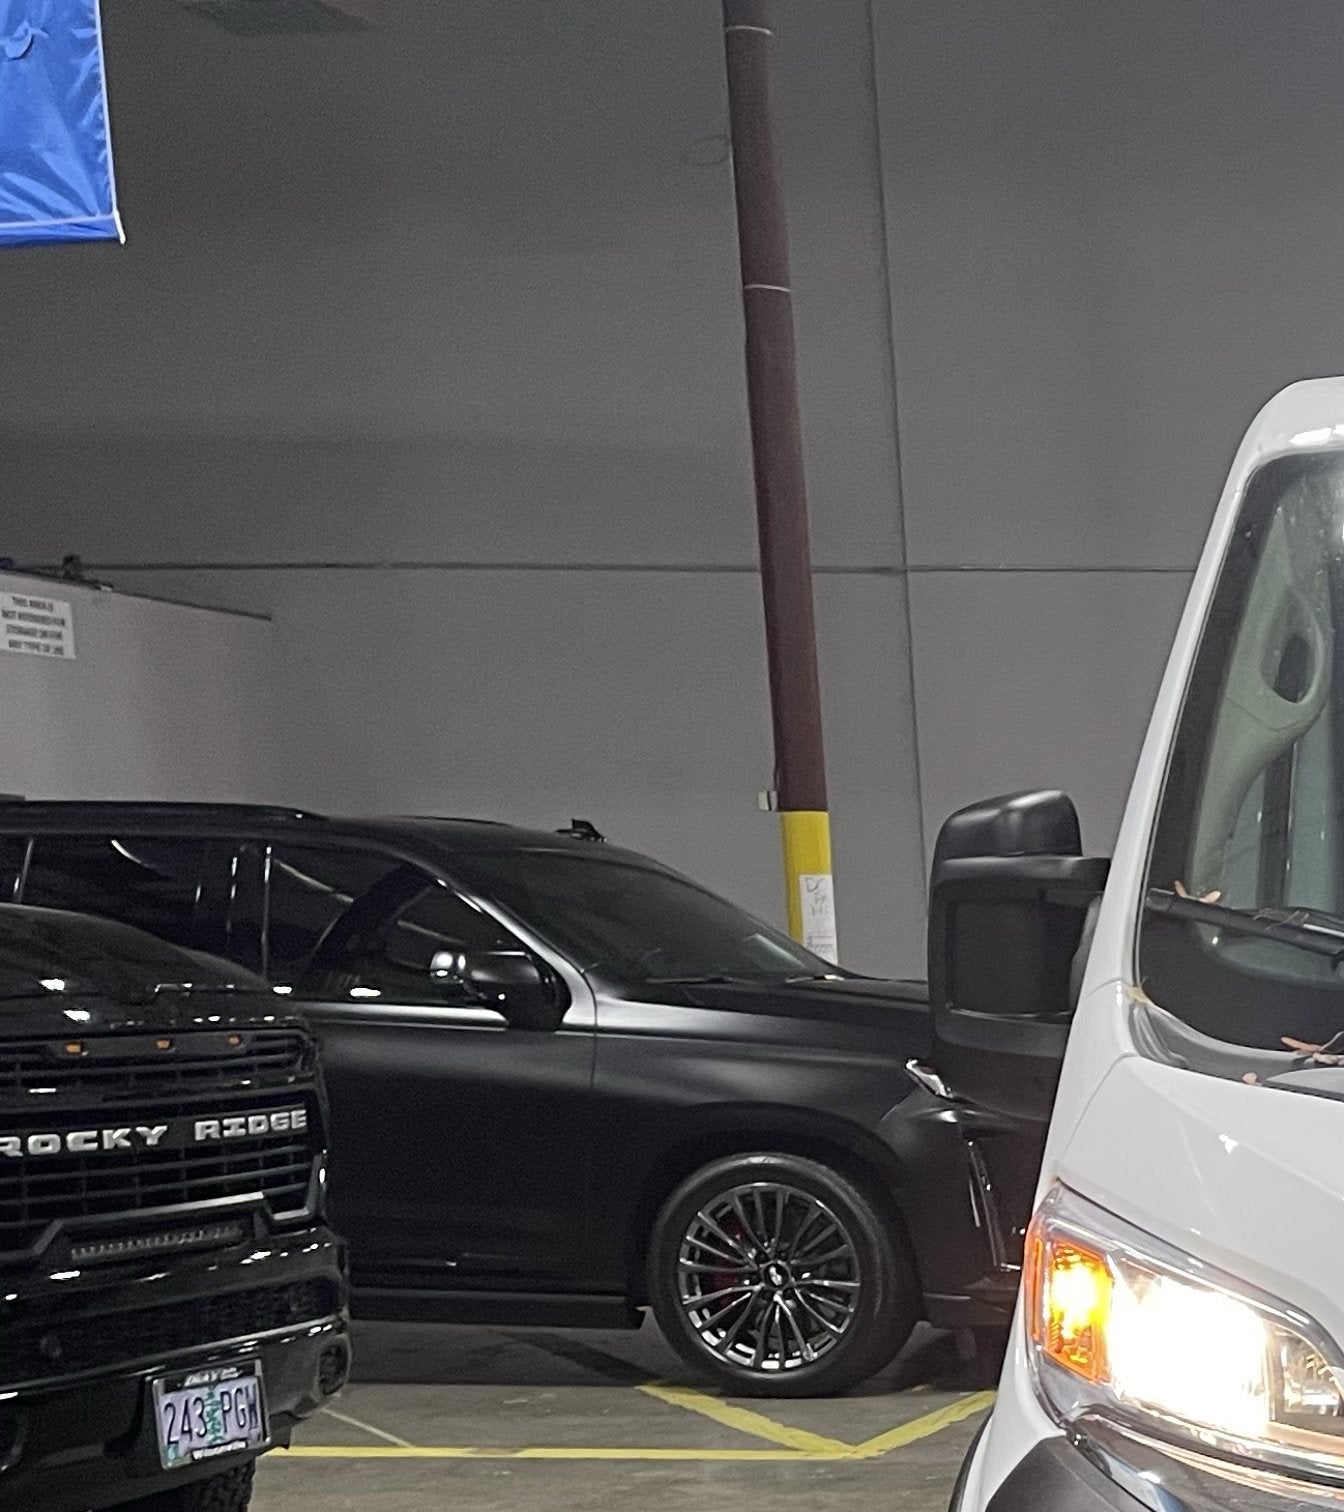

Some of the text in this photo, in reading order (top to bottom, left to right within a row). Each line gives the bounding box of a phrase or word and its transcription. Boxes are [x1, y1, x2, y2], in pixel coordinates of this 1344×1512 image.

[0, 1109, 307, 1157] ROCKY RIDGE
[164, 1396, 207, 1446] 243
